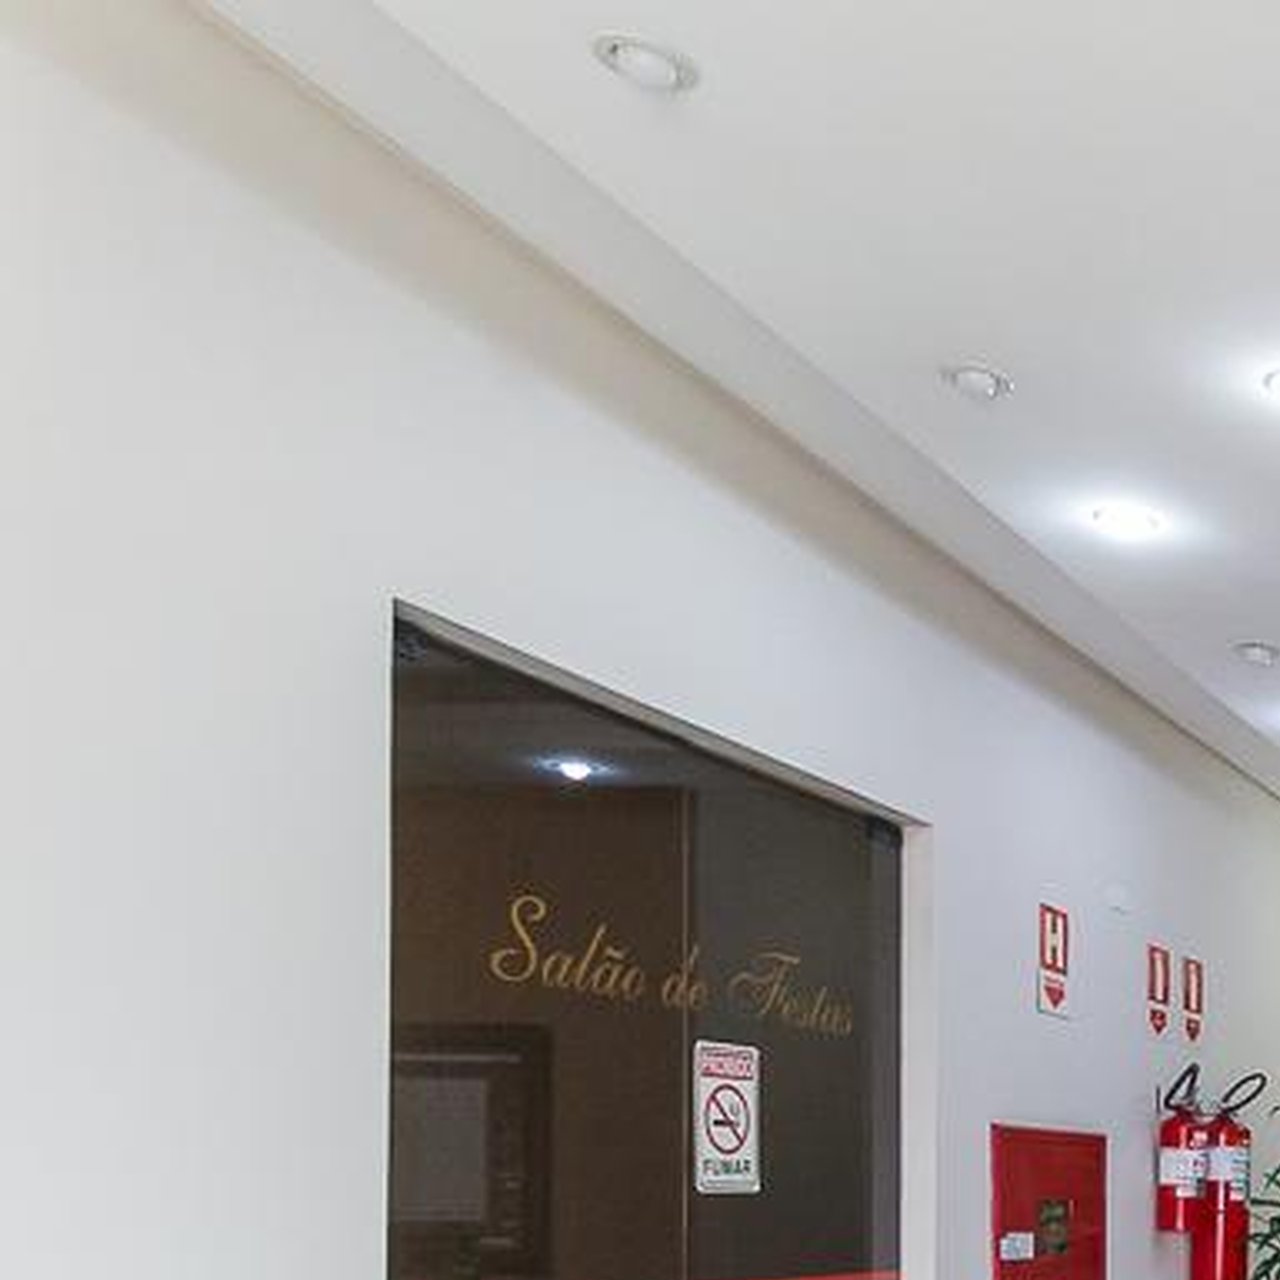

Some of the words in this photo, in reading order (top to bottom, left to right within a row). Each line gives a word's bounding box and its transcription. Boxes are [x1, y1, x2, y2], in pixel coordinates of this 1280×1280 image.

[489, 894, 645, 1002] Salão
[661, 943, 707, 1012] de
[727, 949, 853, 1036] Festas
